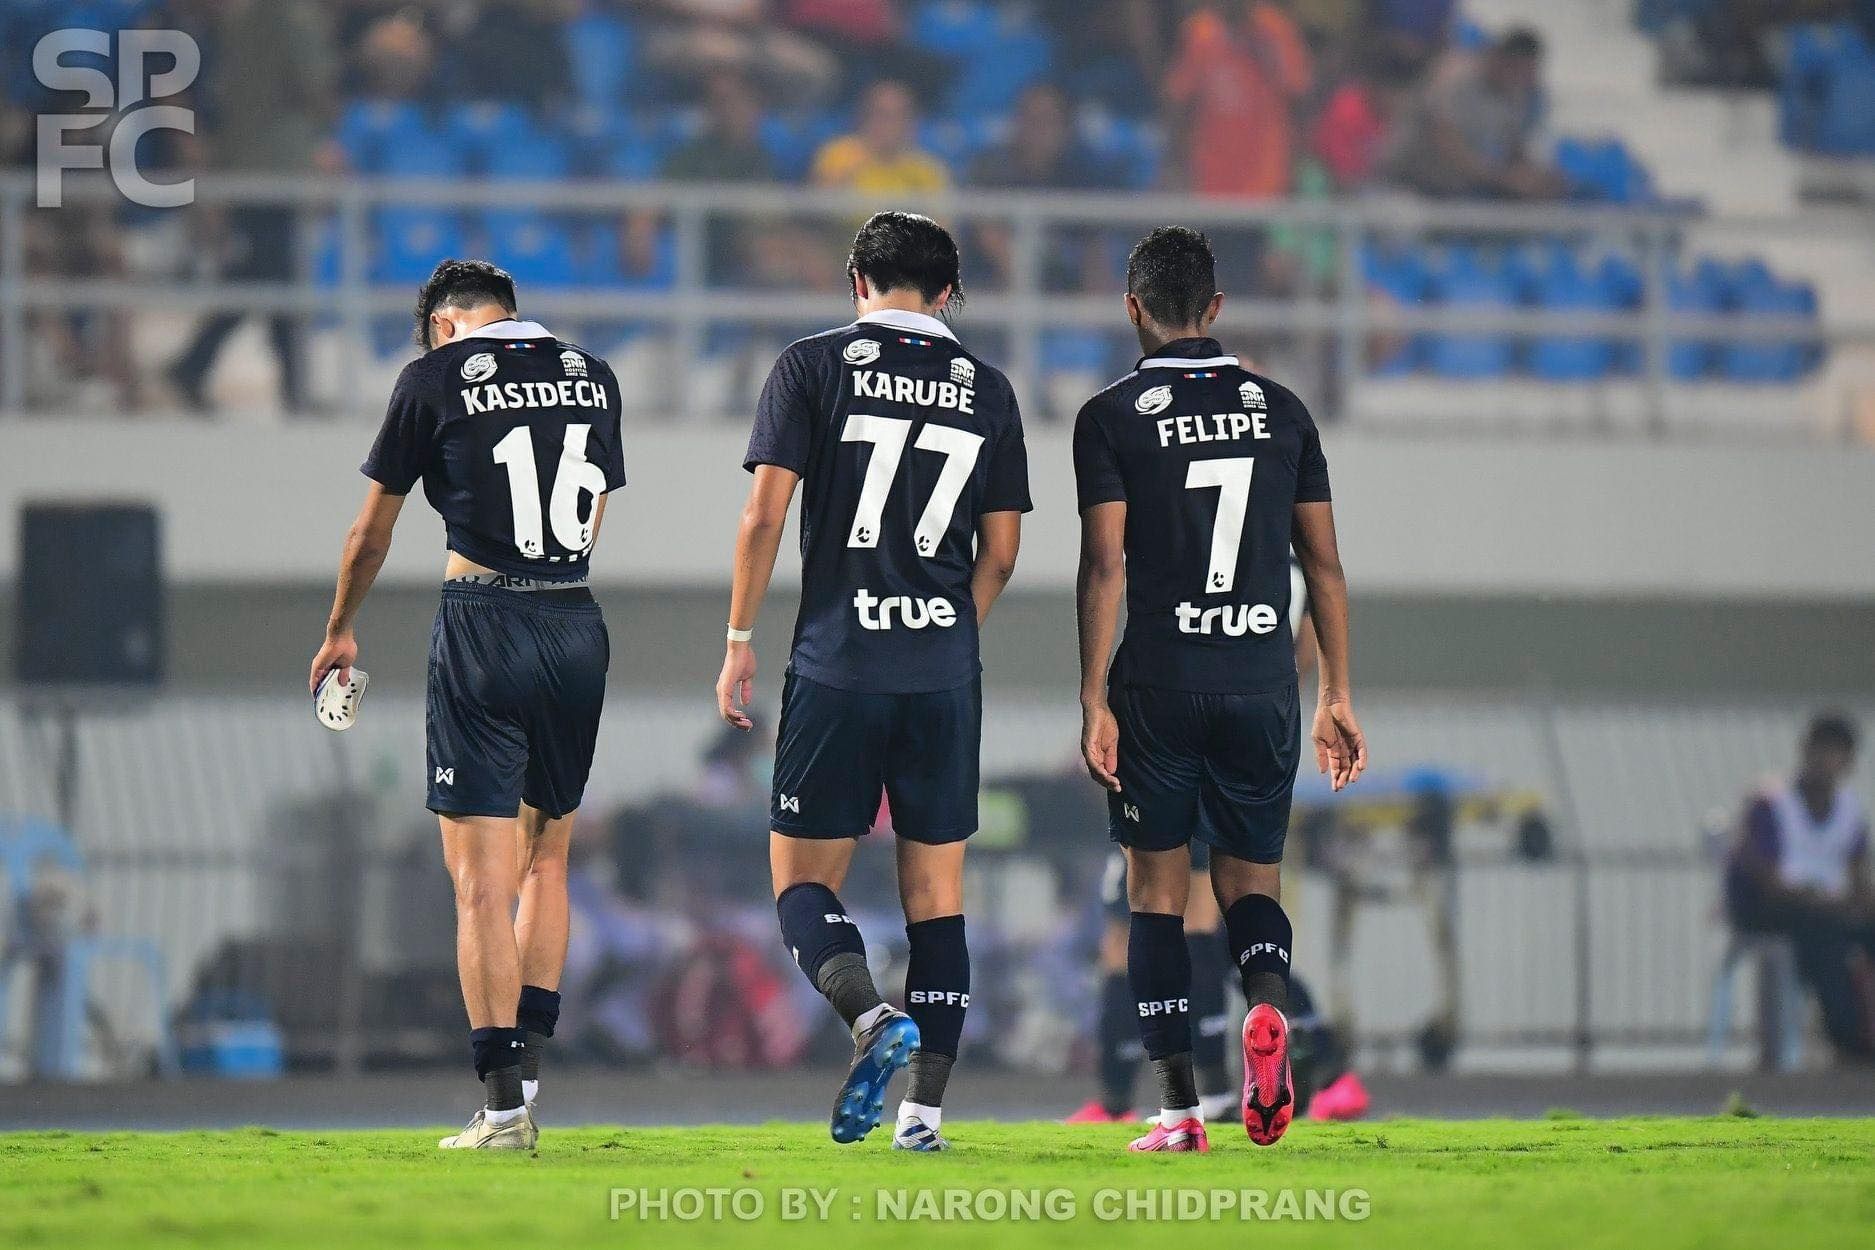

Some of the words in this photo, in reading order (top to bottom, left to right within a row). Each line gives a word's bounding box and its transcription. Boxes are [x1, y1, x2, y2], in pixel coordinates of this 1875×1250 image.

[460, 380, 608, 416] KASIDECH
[852, 370, 976, 415] KARUBE
[1156, 413, 1272, 448] FELIPE
[492, 423, 607, 556] 16
[840, 414, 986, 558] 77
[1184, 457, 1255, 594] 7
[853, 588, 958, 631] true
[1175, 601, 1278, 637] true
[1240, 942, 1289, 966] SPFC
[910, 990, 970, 1008] SPFC
[1138, 998, 1188, 1018] SPFC
